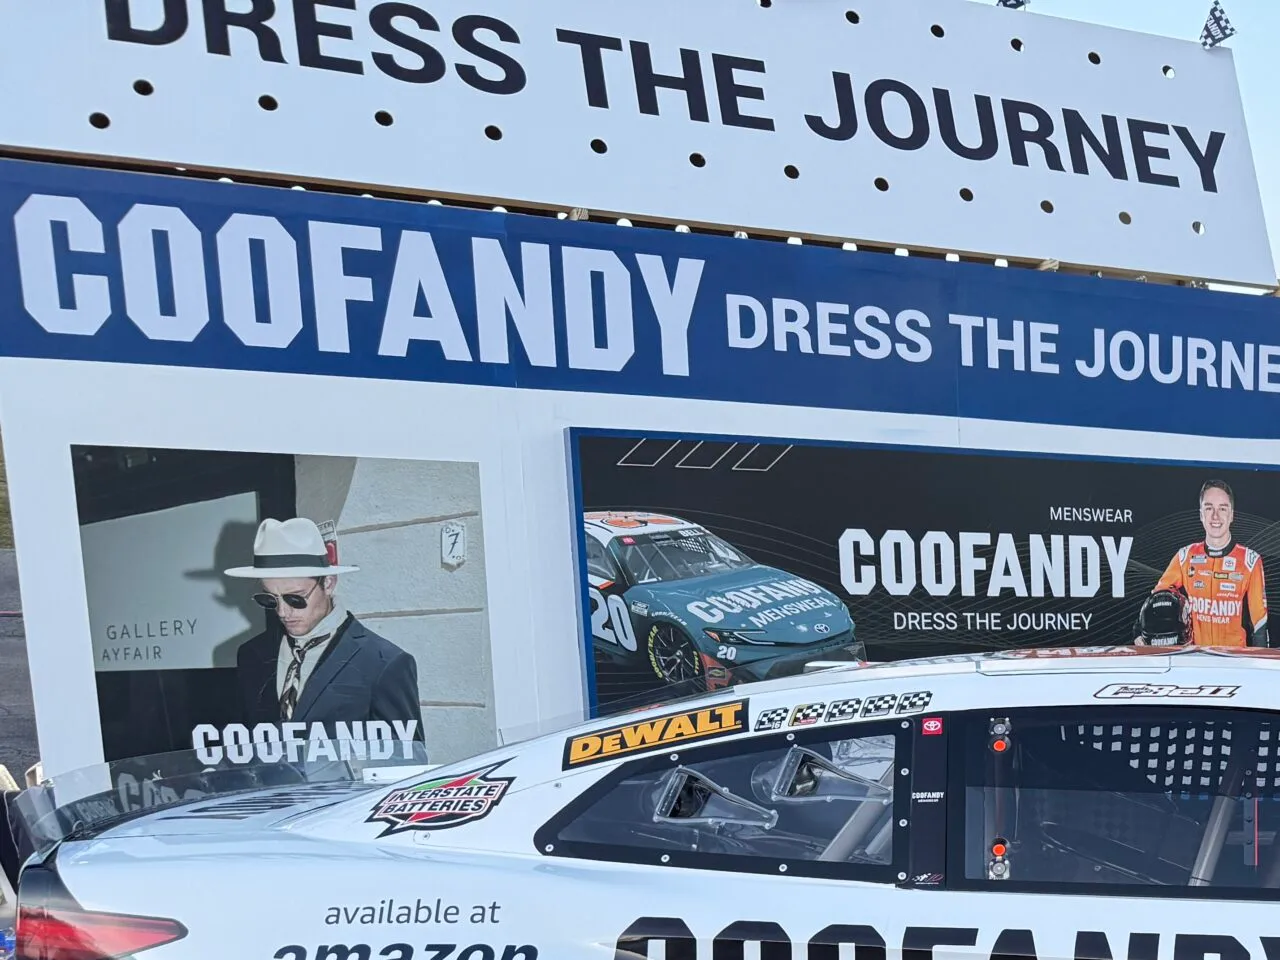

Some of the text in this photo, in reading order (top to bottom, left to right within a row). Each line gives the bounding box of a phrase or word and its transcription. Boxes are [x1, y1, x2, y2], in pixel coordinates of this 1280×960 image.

[104, 0, 1226, 194] DRESS THE JOURNEY
[13, 193, 705, 377] COOFANDY
[725, 293, 932, 363] DRESS
[949, 314, 1060, 375] THE
[1050, 506, 1133, 523] MENSWEAR
[446, 532, 460, 556] 7
[838, 528, 1134, 598] COOFANDY
[106, 618, 199, 641] GALLERY
[588, 586, 638, 652] 20
[894, 612, 1093, 631] DRESS THE JOURNEY
[717, 645, 737, 661] 20
[192, 719, 419, 765] COOFANDY
[388, 784, 497, 803] INTERSTATE
[382, 799, 486, 814] BATTERIES
[325, 898, 501, 926] available at
